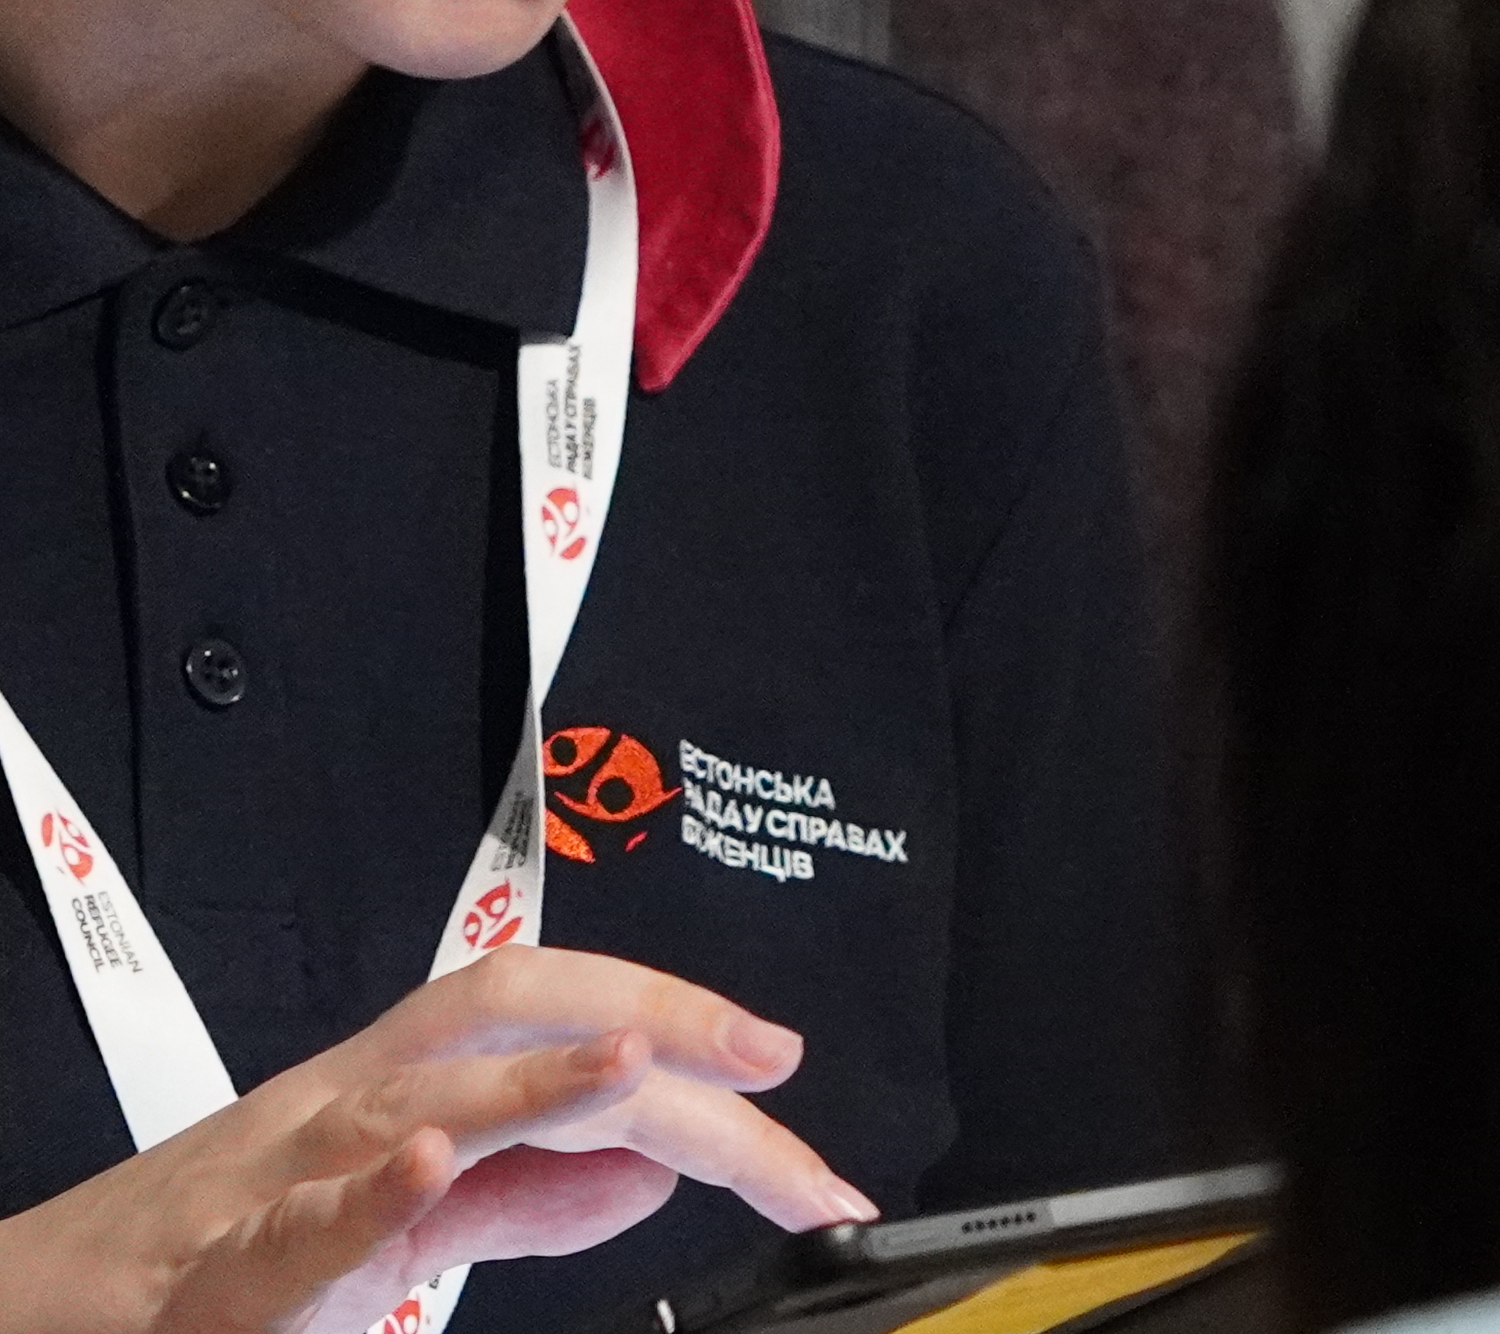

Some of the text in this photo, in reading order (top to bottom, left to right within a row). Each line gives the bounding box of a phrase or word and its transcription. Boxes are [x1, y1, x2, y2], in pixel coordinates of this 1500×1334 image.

[765, 808, 909, 864] СПРАВАХ
[71, 897, 105, 974] COUNCIL
[83, 894, 124, 969] REFUGEE
[97, 890, 143, 974] ESTONIAN
